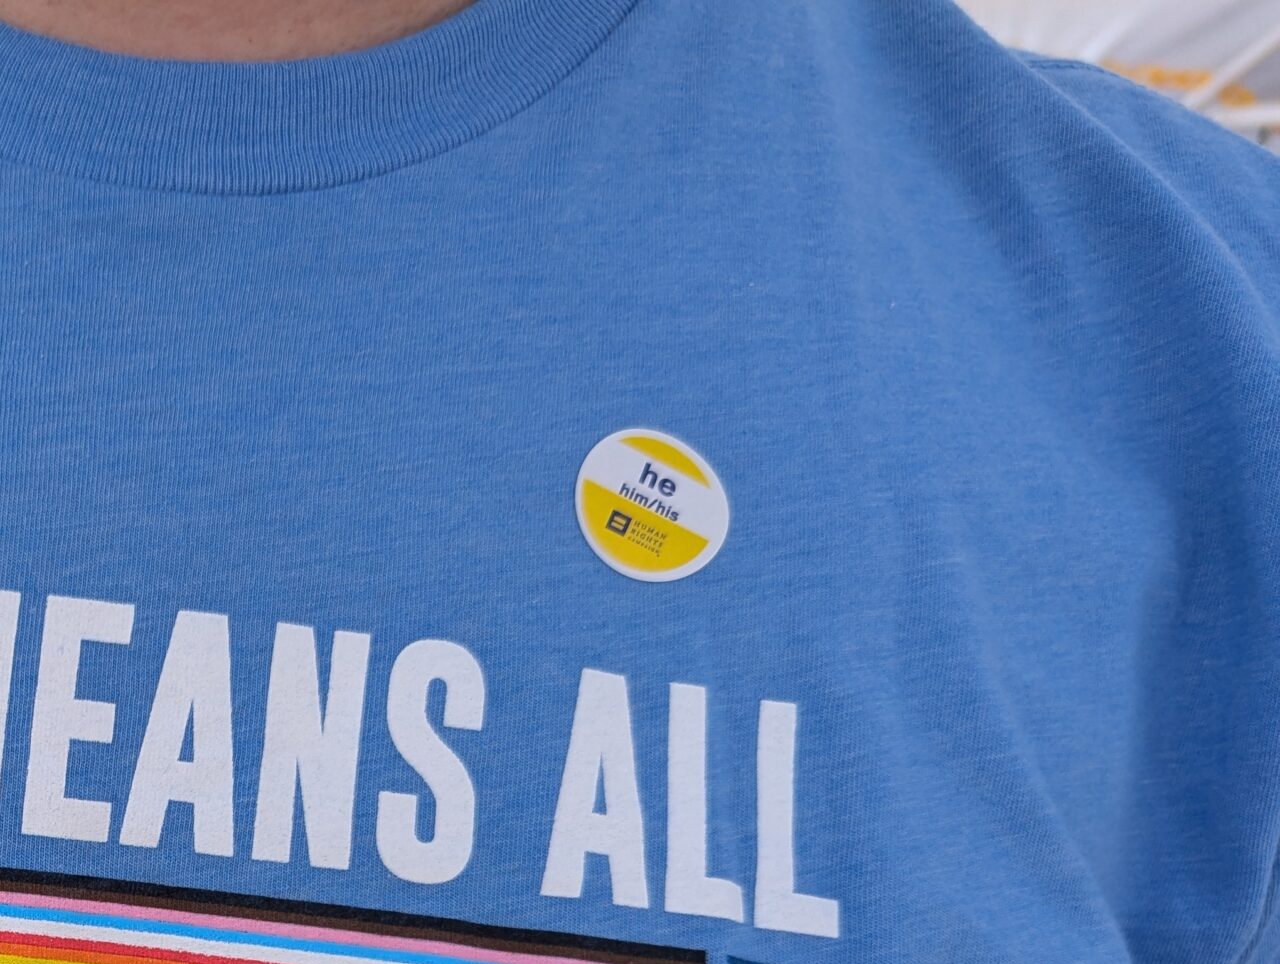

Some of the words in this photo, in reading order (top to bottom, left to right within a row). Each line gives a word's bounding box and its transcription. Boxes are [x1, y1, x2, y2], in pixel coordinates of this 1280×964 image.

[639, 462, 677, 497] he
[618, 483, 680, 522] him/his
[634, 520, 668, 541] HUMAN
[541, 669, 840, 938] ALL
